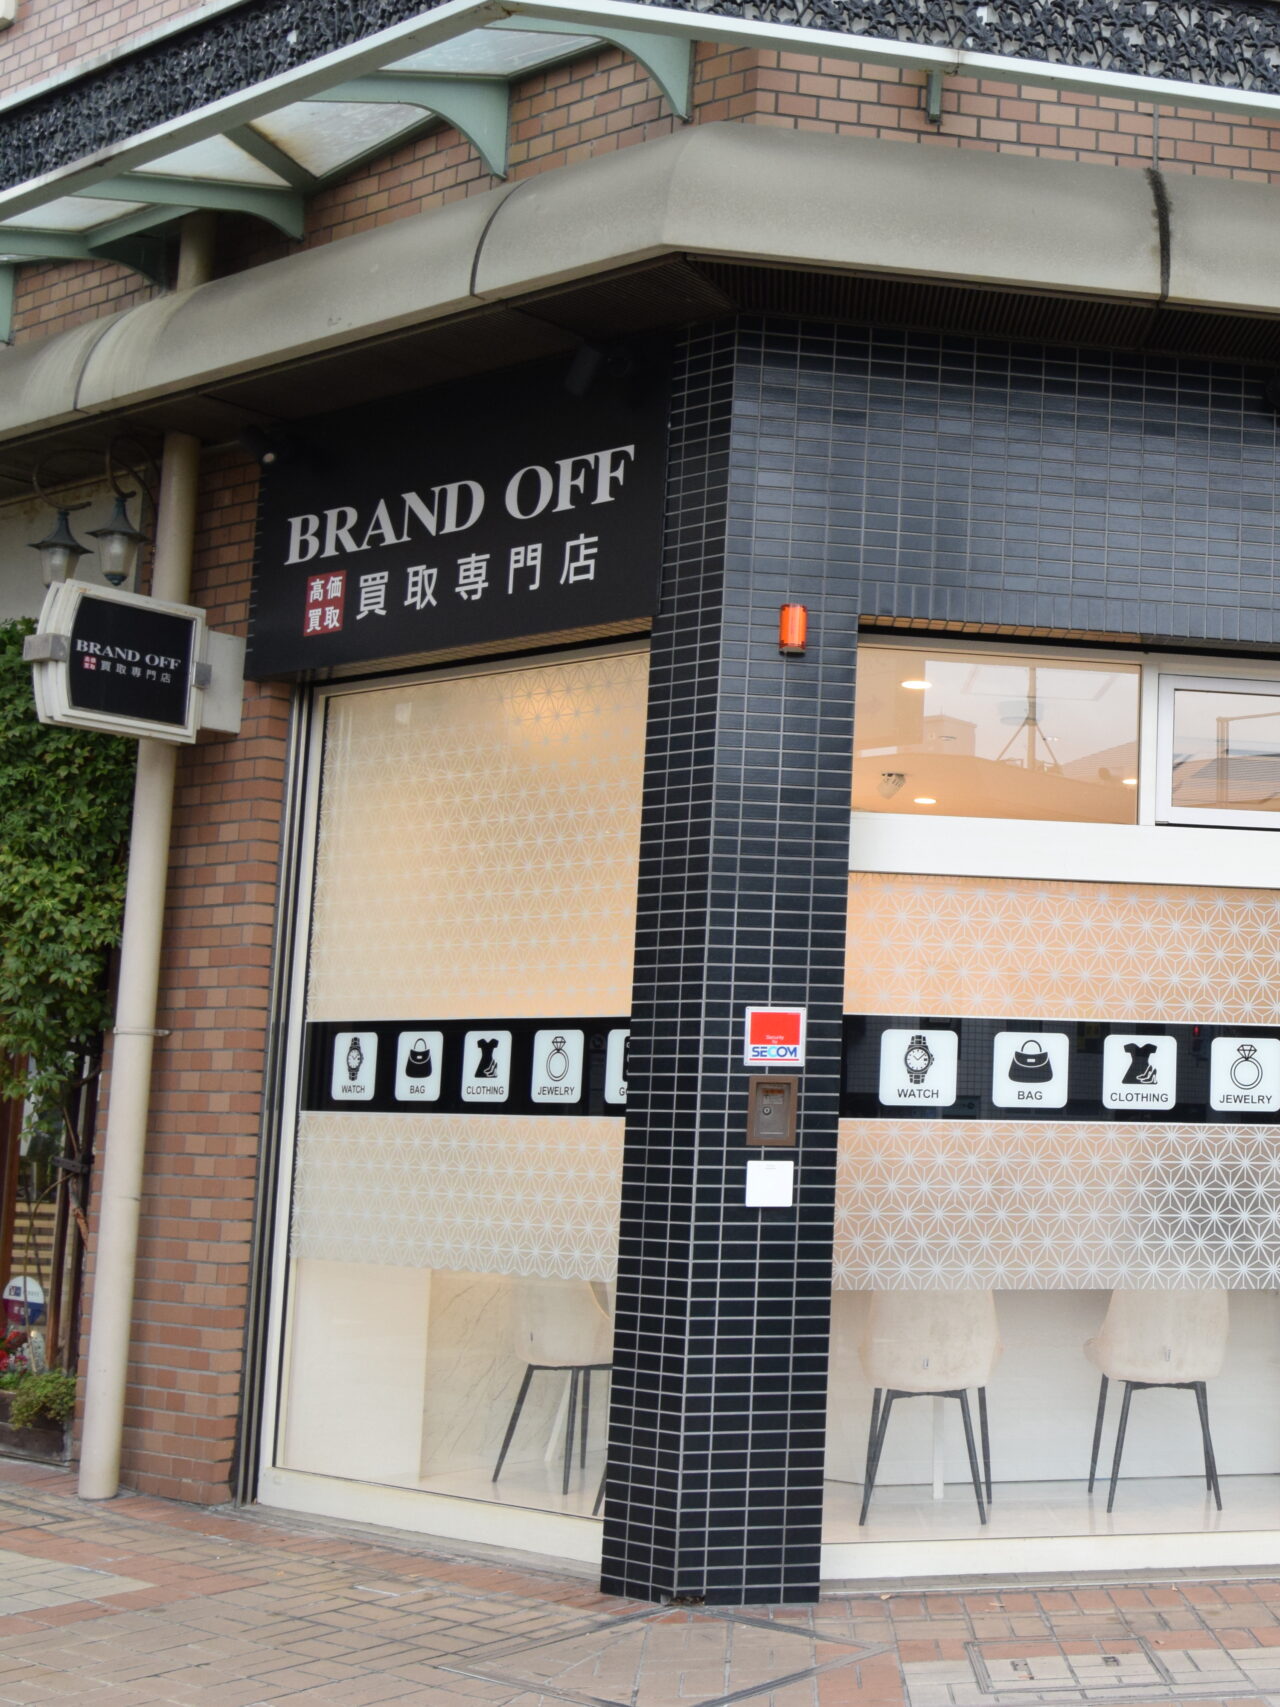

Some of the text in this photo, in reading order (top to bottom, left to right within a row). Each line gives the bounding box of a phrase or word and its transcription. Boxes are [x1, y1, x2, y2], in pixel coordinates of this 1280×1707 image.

[284, 444, 635, 565] BRAND OFF
[356, 532, 600, 620] 買取専門店
[309, 574, 343, 603] 高価
[306, 605, 341, 634] 買取
[76, 639, 181, 670] BRAND OFF
[751, 1046, 798, 1058] SECOM
[341, 1084, 366, 1094] WATCH
[409, 1085, 426, 1094] BAG
[466, 1085, 505, 1096] CLOTHING
[537, 1086, 575, 1096] JEWELRY
[896, 1088, 940, 1100] WATCH
[1016, 1090, 1044, 1102] BAG
[1109, 1091, 1169, 1104] CLOTHING
[1218, 1093, 1273, 1105] JEWELRY
